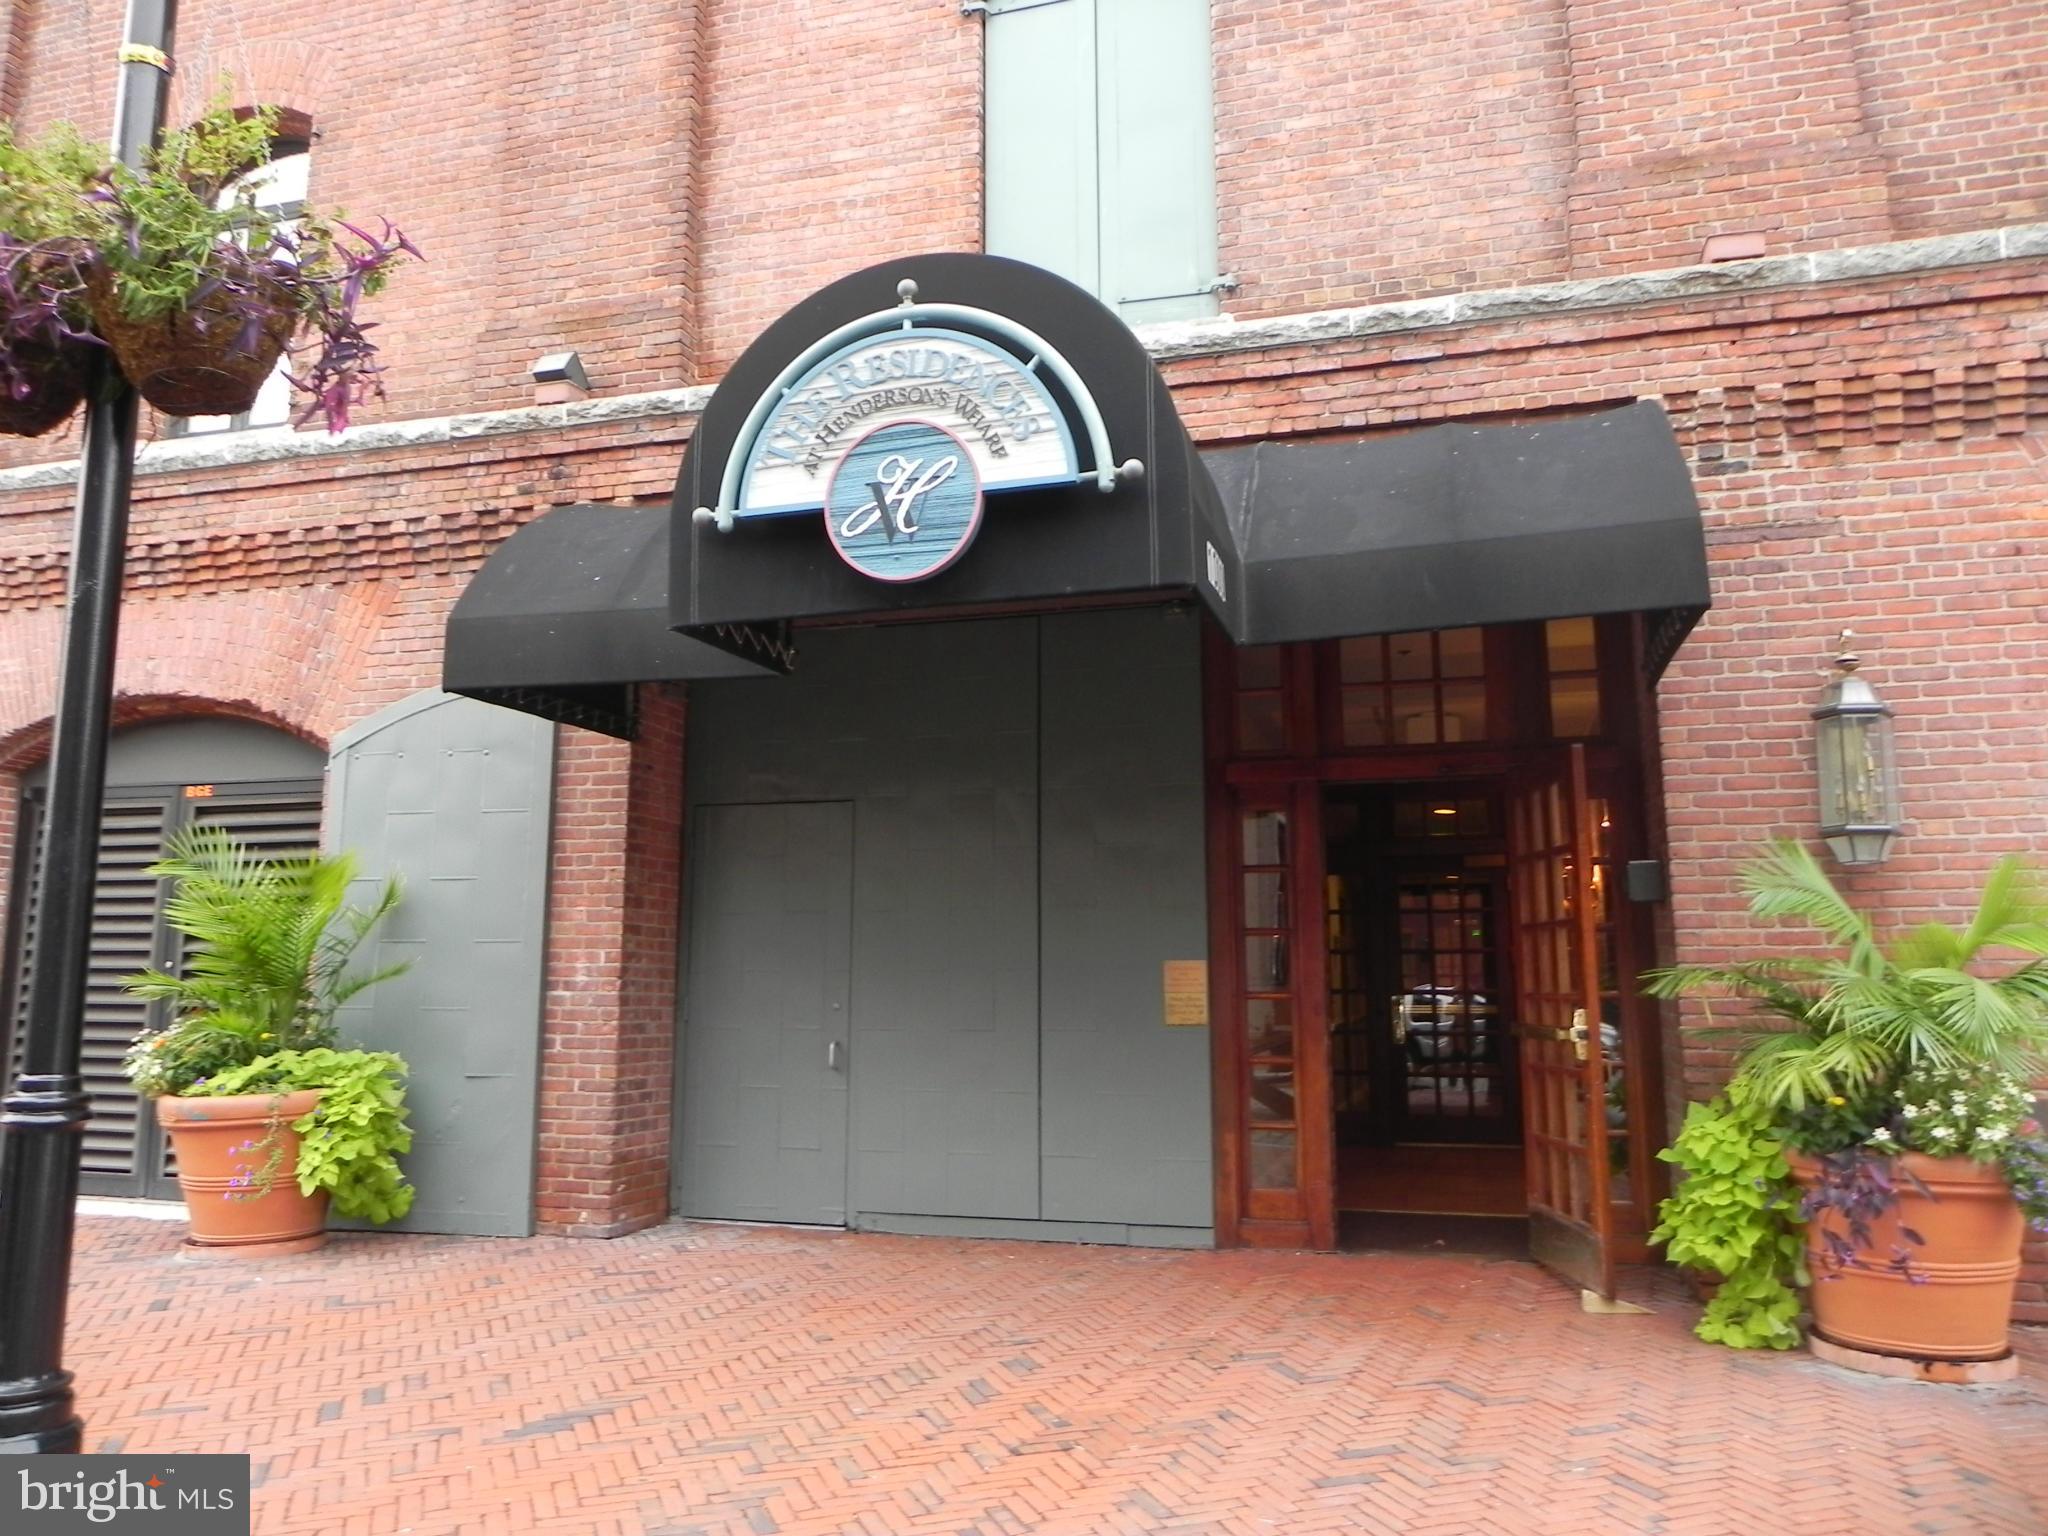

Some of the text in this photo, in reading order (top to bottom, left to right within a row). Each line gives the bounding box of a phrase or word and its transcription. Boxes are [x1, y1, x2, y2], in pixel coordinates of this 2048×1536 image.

[755, 348, 1041, 468] THE RESIDENCES
[803, 386, 1009, 478] AT HENDERSON'S WHARF
